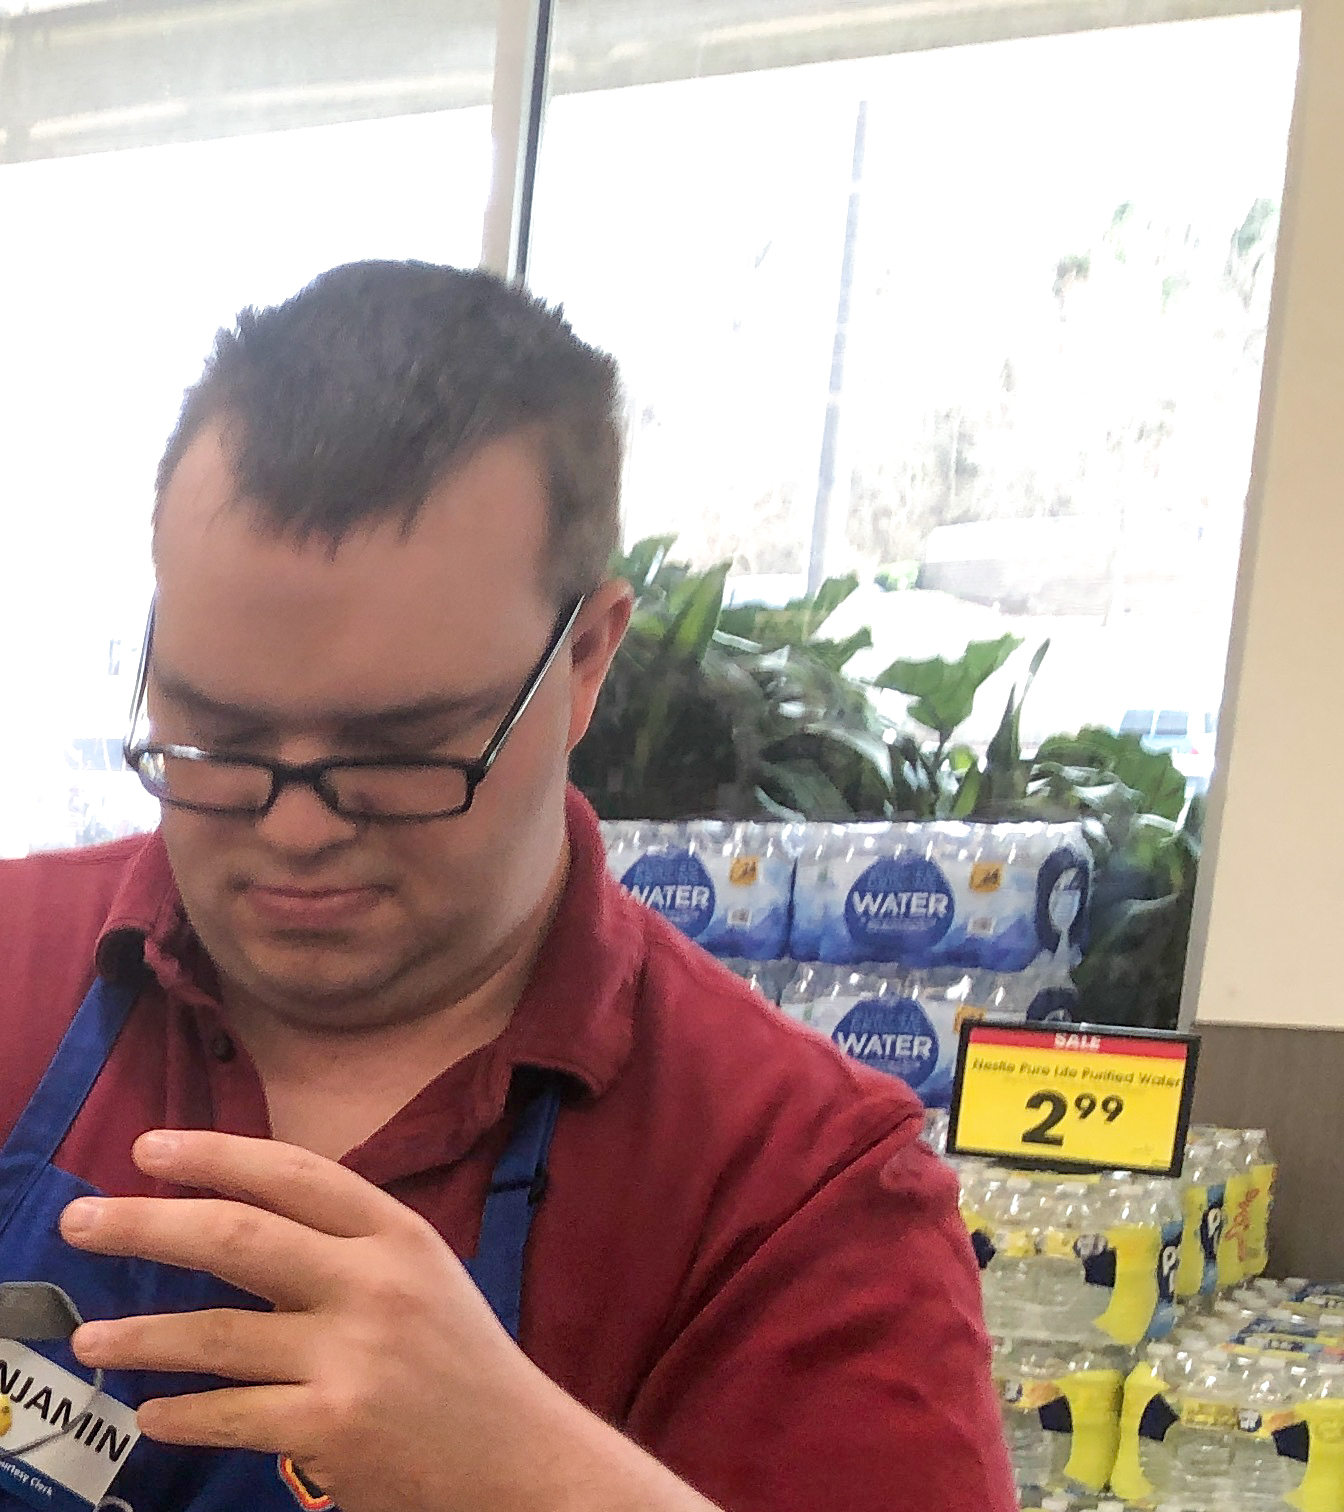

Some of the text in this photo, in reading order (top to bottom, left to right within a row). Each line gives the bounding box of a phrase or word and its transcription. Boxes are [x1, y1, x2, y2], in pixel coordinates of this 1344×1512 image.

[853, 890, 951, 918] WATER
[837, 1031, 933, 1061] WATER
[1053, 1033, 1101, 1051] SALE
[1019, 1062, 1051, 1077] Pure
[1082, 1067, 1134, 1084] Purified
[1138, 1072, 1183, 1088] Water
